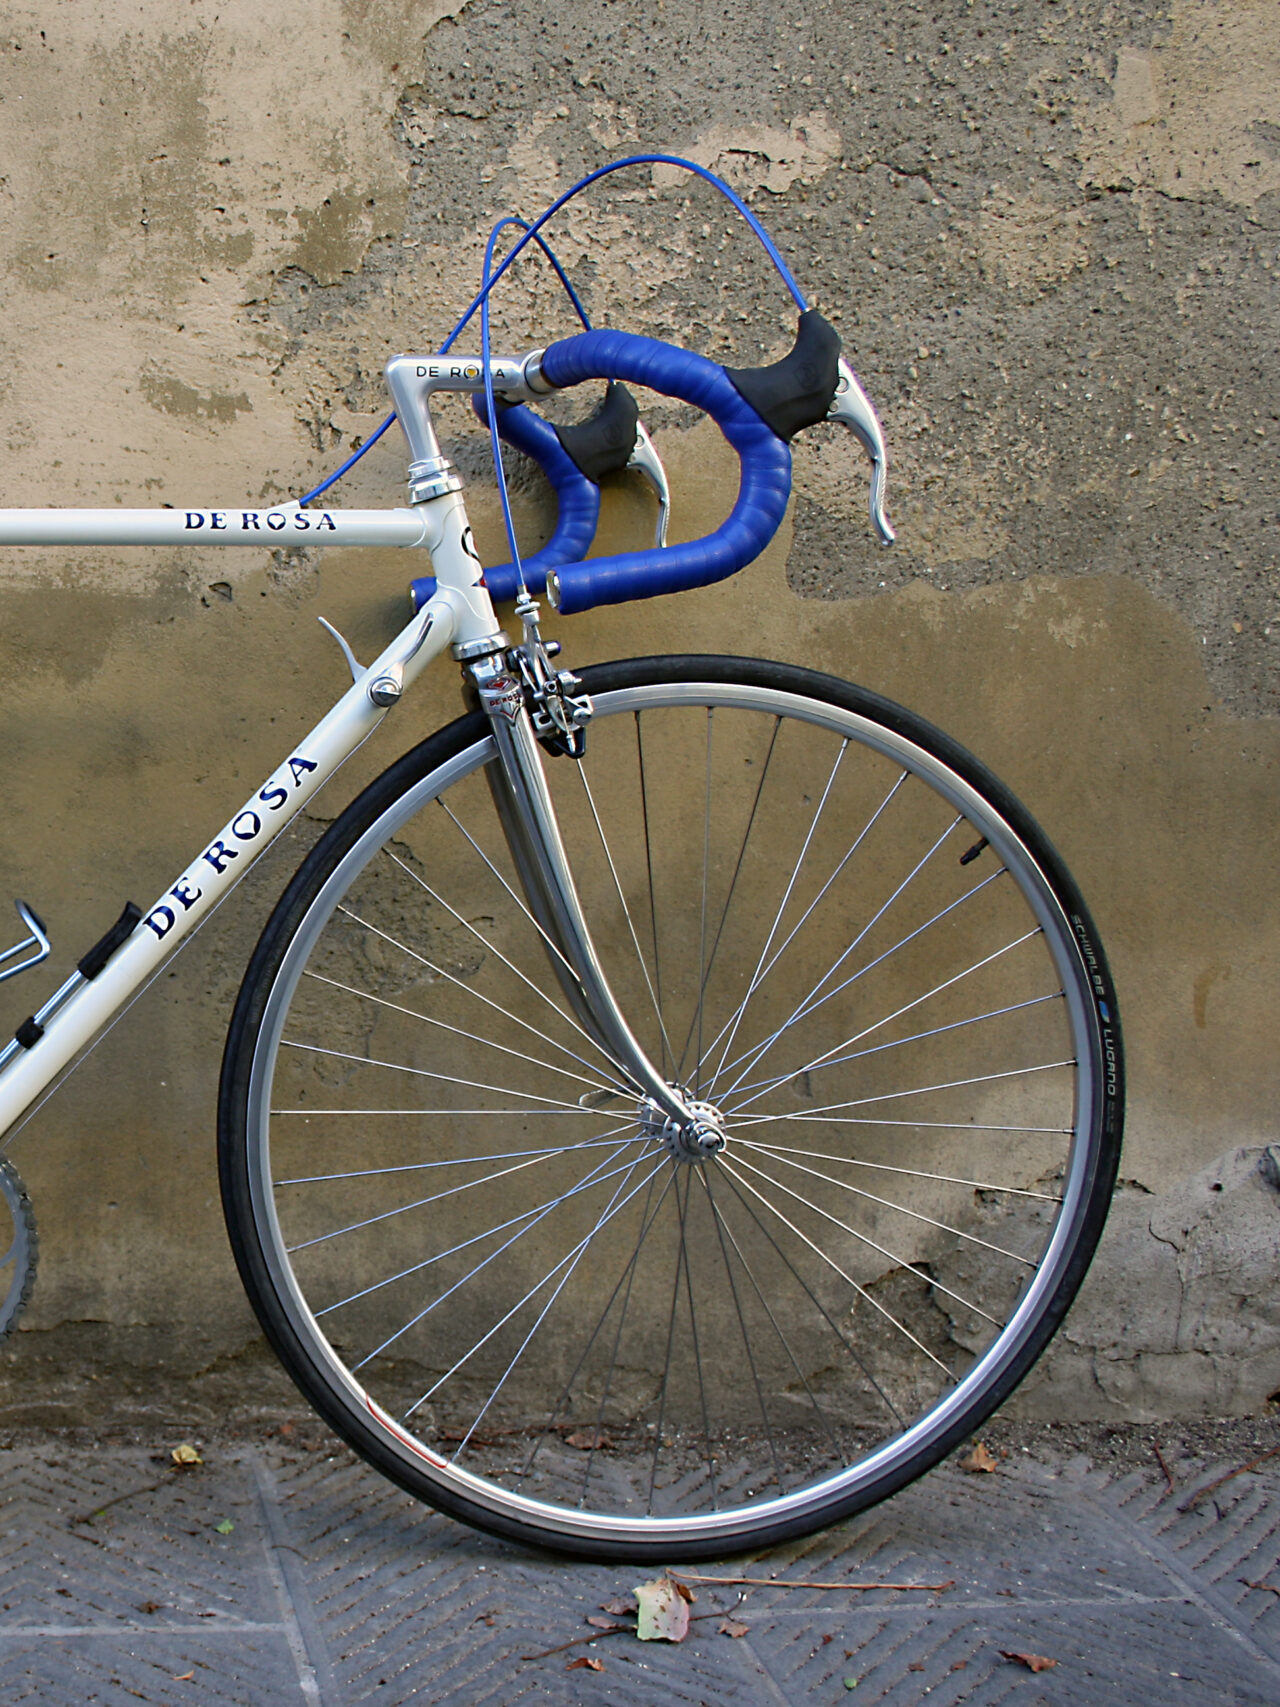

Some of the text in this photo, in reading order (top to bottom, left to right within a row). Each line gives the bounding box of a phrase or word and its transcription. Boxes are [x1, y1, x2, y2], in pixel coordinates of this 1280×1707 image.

[416, 364, 505, 380] DE ROA
[185, 512, 337, 531] DE ROSA
[142, 757, 319, 941] DE ROSA
[1070, 913, 1106, 996] SCHWALBE
[1103, 1027, 1117, 1097] LUGANO
